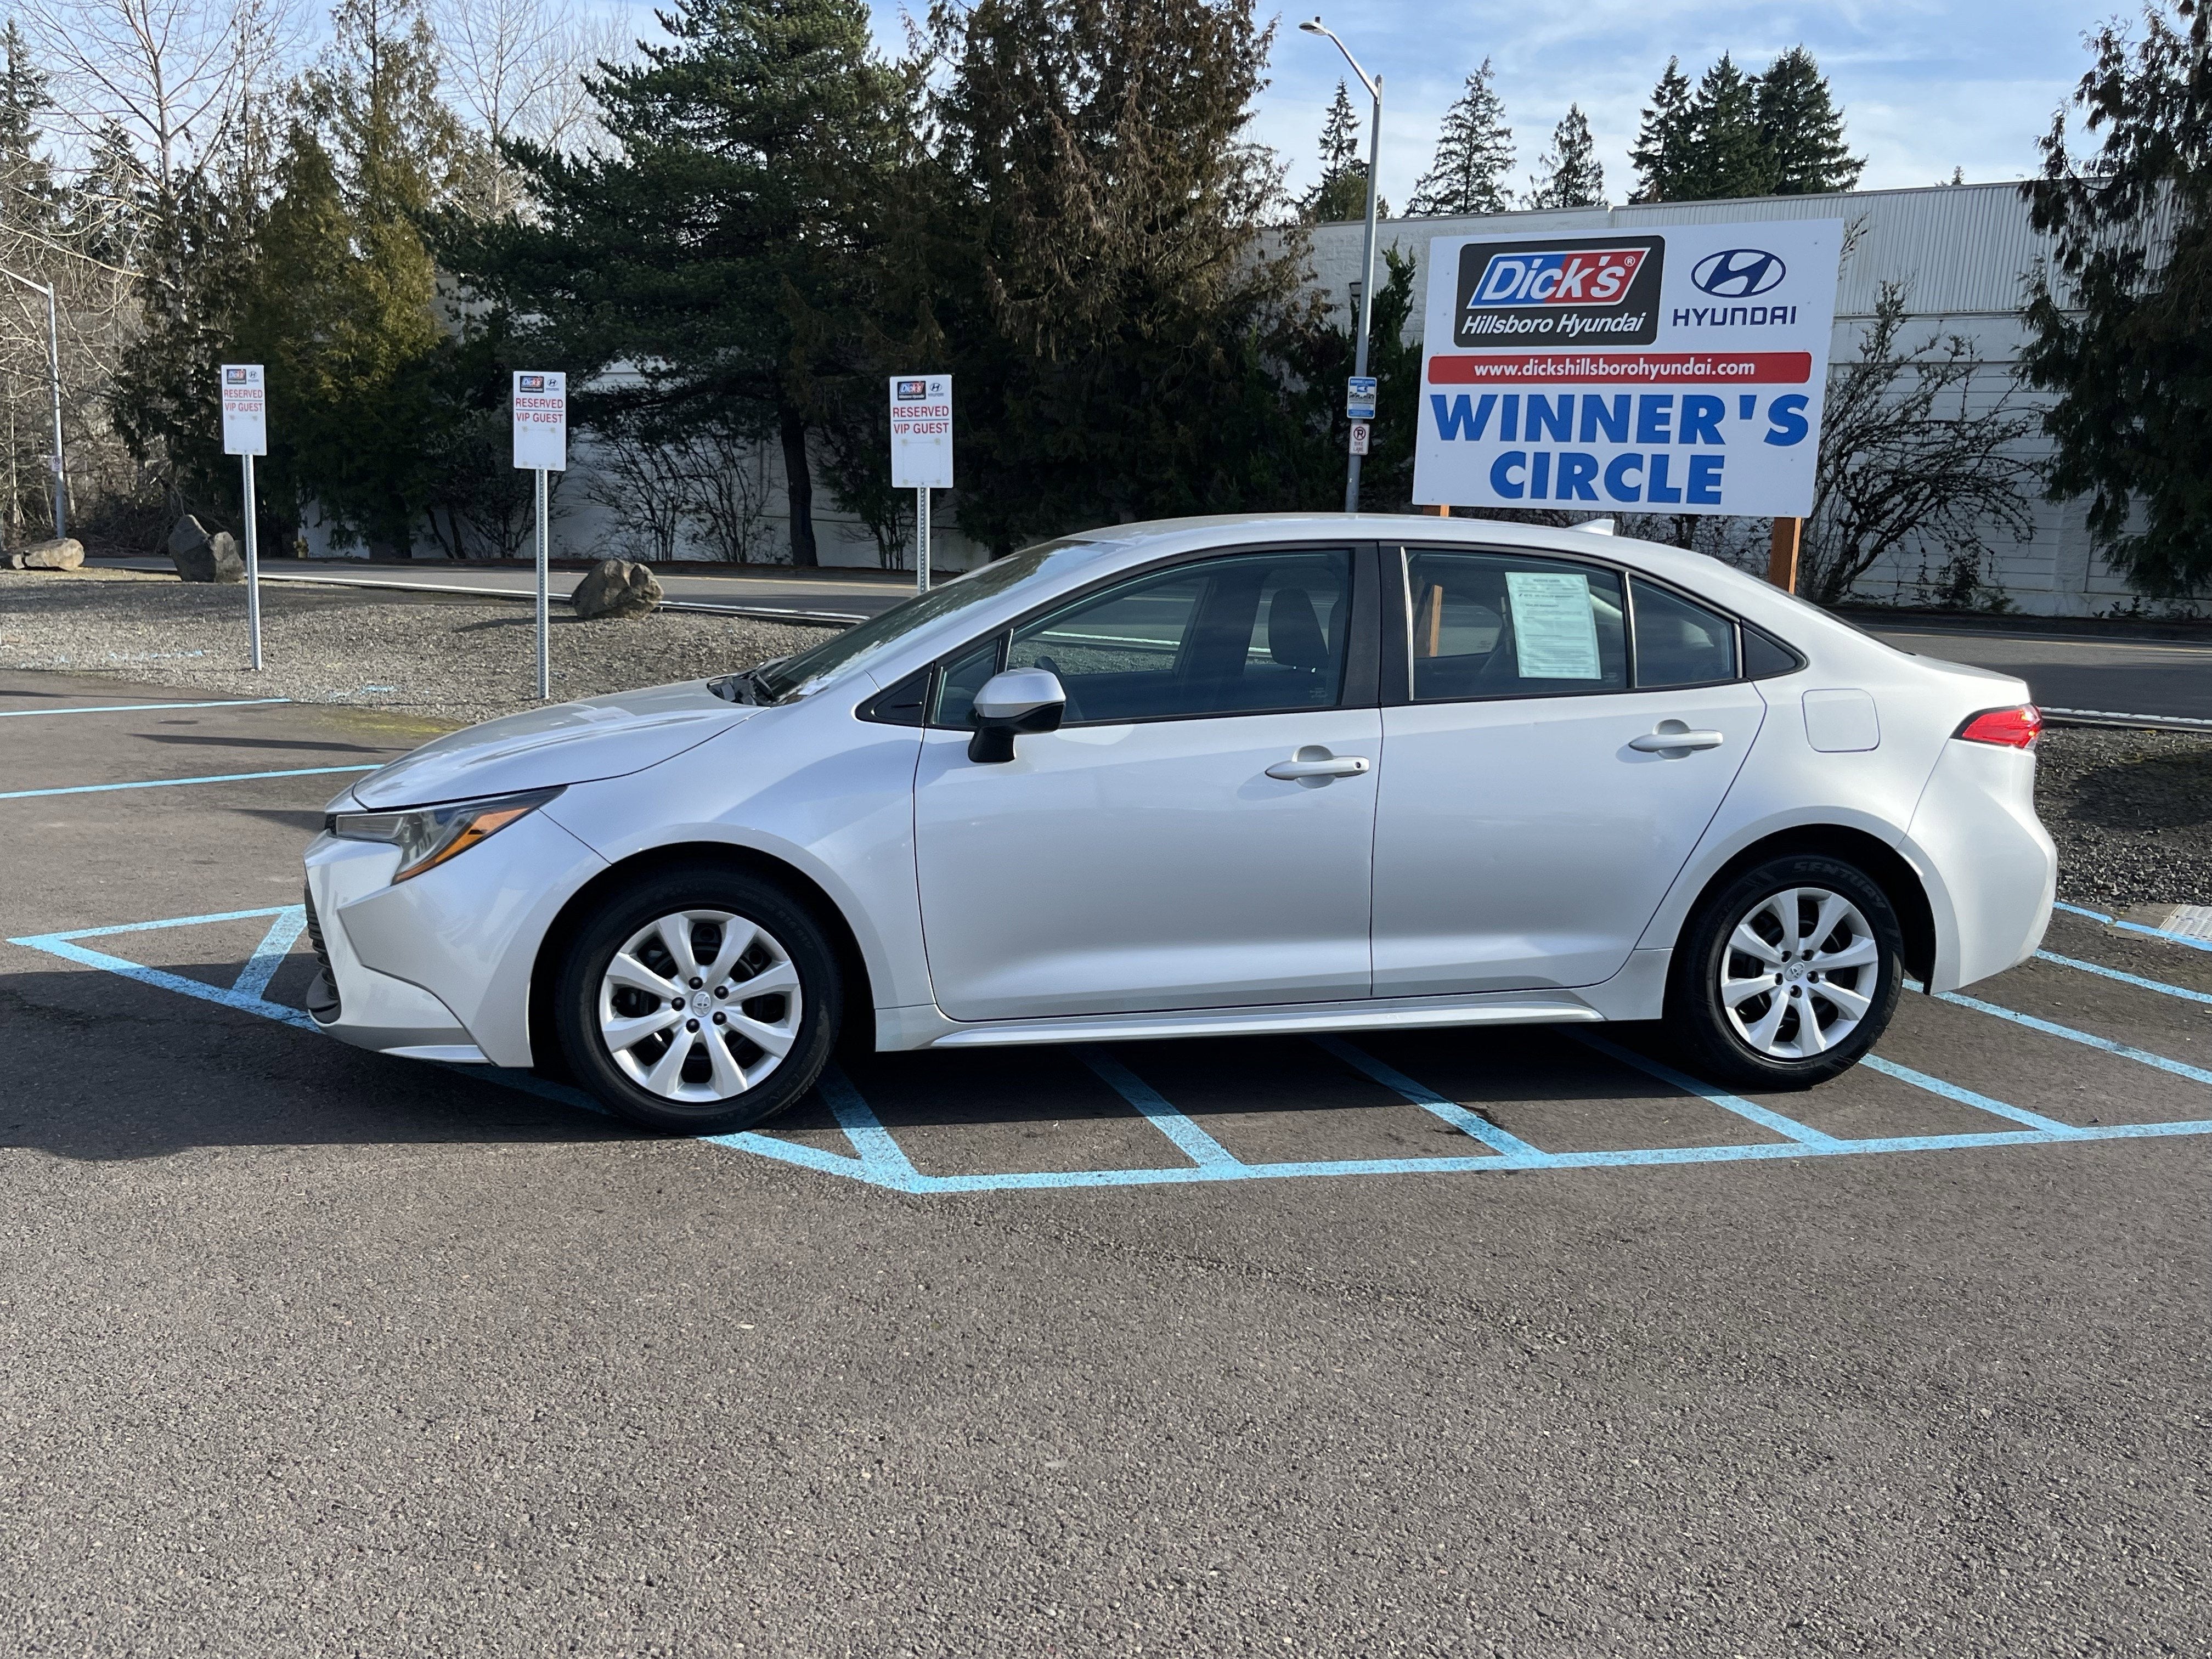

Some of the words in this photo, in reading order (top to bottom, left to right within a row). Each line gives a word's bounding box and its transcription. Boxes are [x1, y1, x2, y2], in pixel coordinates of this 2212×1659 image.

[1481, 256, 1625, 301] Dick's
[1673, 306, 1796, 327] HYUNDAI
[1462, 314, 1554, 335] Hillsboro
[1556, 312, 1647, 338] Hyundai
[1474, 357, 1755, 380] www.dickshillsborohyundai.com
[224, 388, 263, 398] RESERVED
[224, 402, 236, 411] VIP
[238, 402, 263, 411] GUEST
[516, 398, 563, 409] RESERVED
[893, 406, 949, 417] RESERVED
[516, 413, 530, 422] VIP
[533, 413, 563, 423] GUEST
[1430, 393, 1810, 447] WINNER'S
[894, 424, 910, 433] VIP
[913, 423, 949, 433] GUEST
[1489, 450, 1725, 505] CIRCLE
